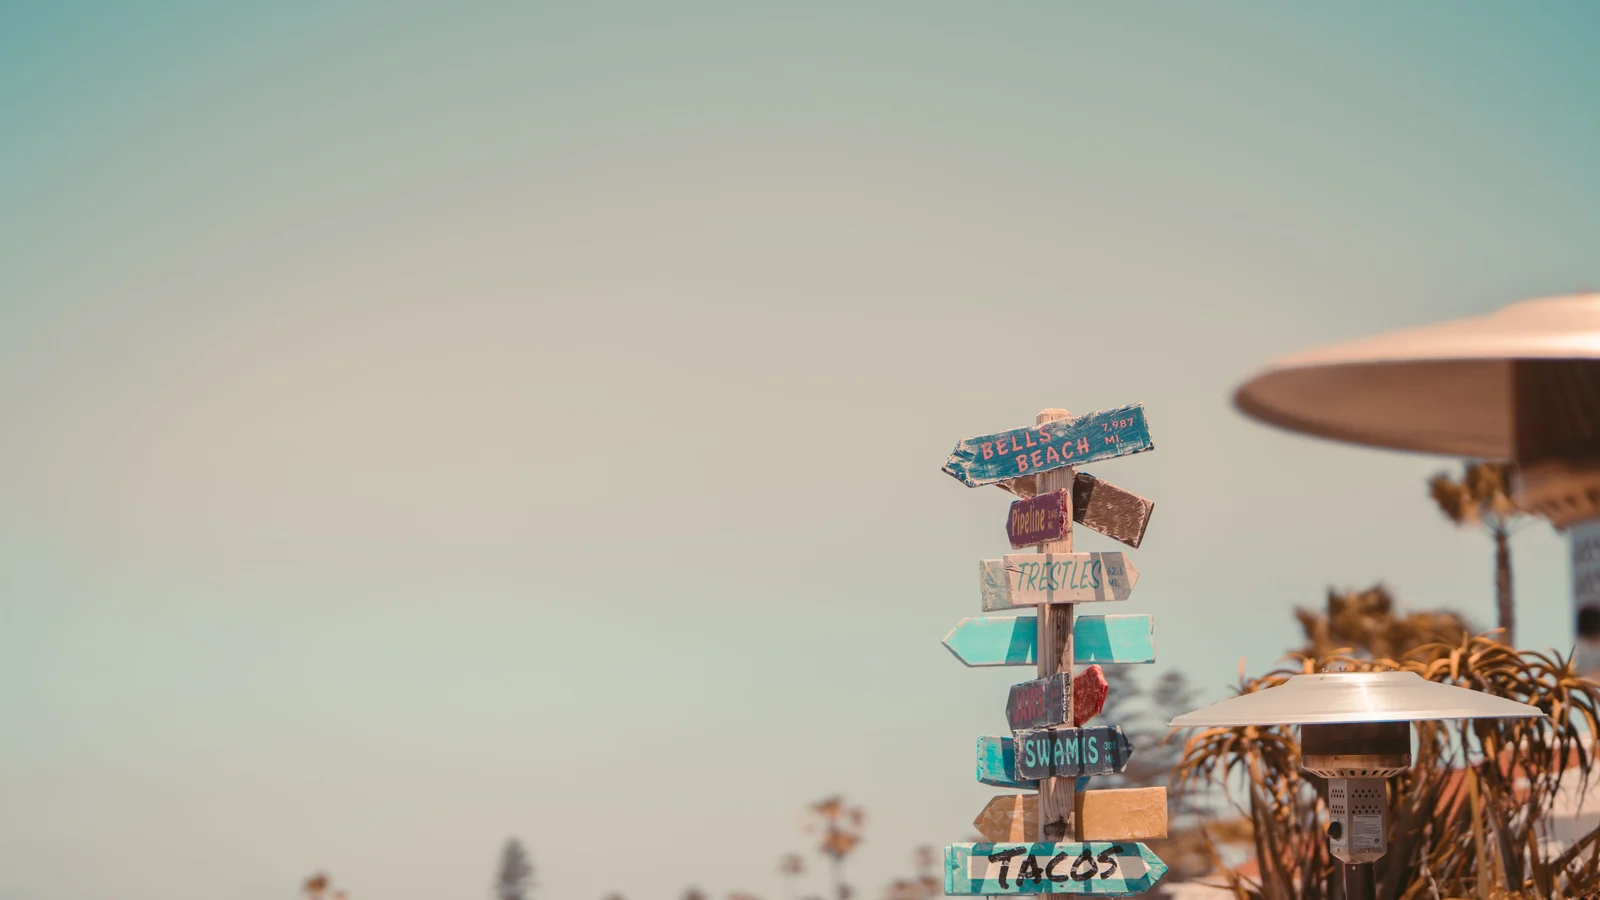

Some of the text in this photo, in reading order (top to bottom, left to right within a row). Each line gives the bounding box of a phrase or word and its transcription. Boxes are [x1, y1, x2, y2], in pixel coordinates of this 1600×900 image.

[1101, 417, 1134, 432] 7,987
[1104, 435, 1124, 446] MI.
[980, 425, 1052, 460] BELLS
[1015, 437, 1090, 473] BEACH
[1011, 505, 1045, 537] Pipeline
[1018, 560, 1102, 592] TRESTLES
[1107, 566, 1123, 576] 62.1
[1013, 685, 1044, 722] JAWS
[1025, 736, 1099, 768] SWAMIS
[988, 846, 1124, 890] TACOS
